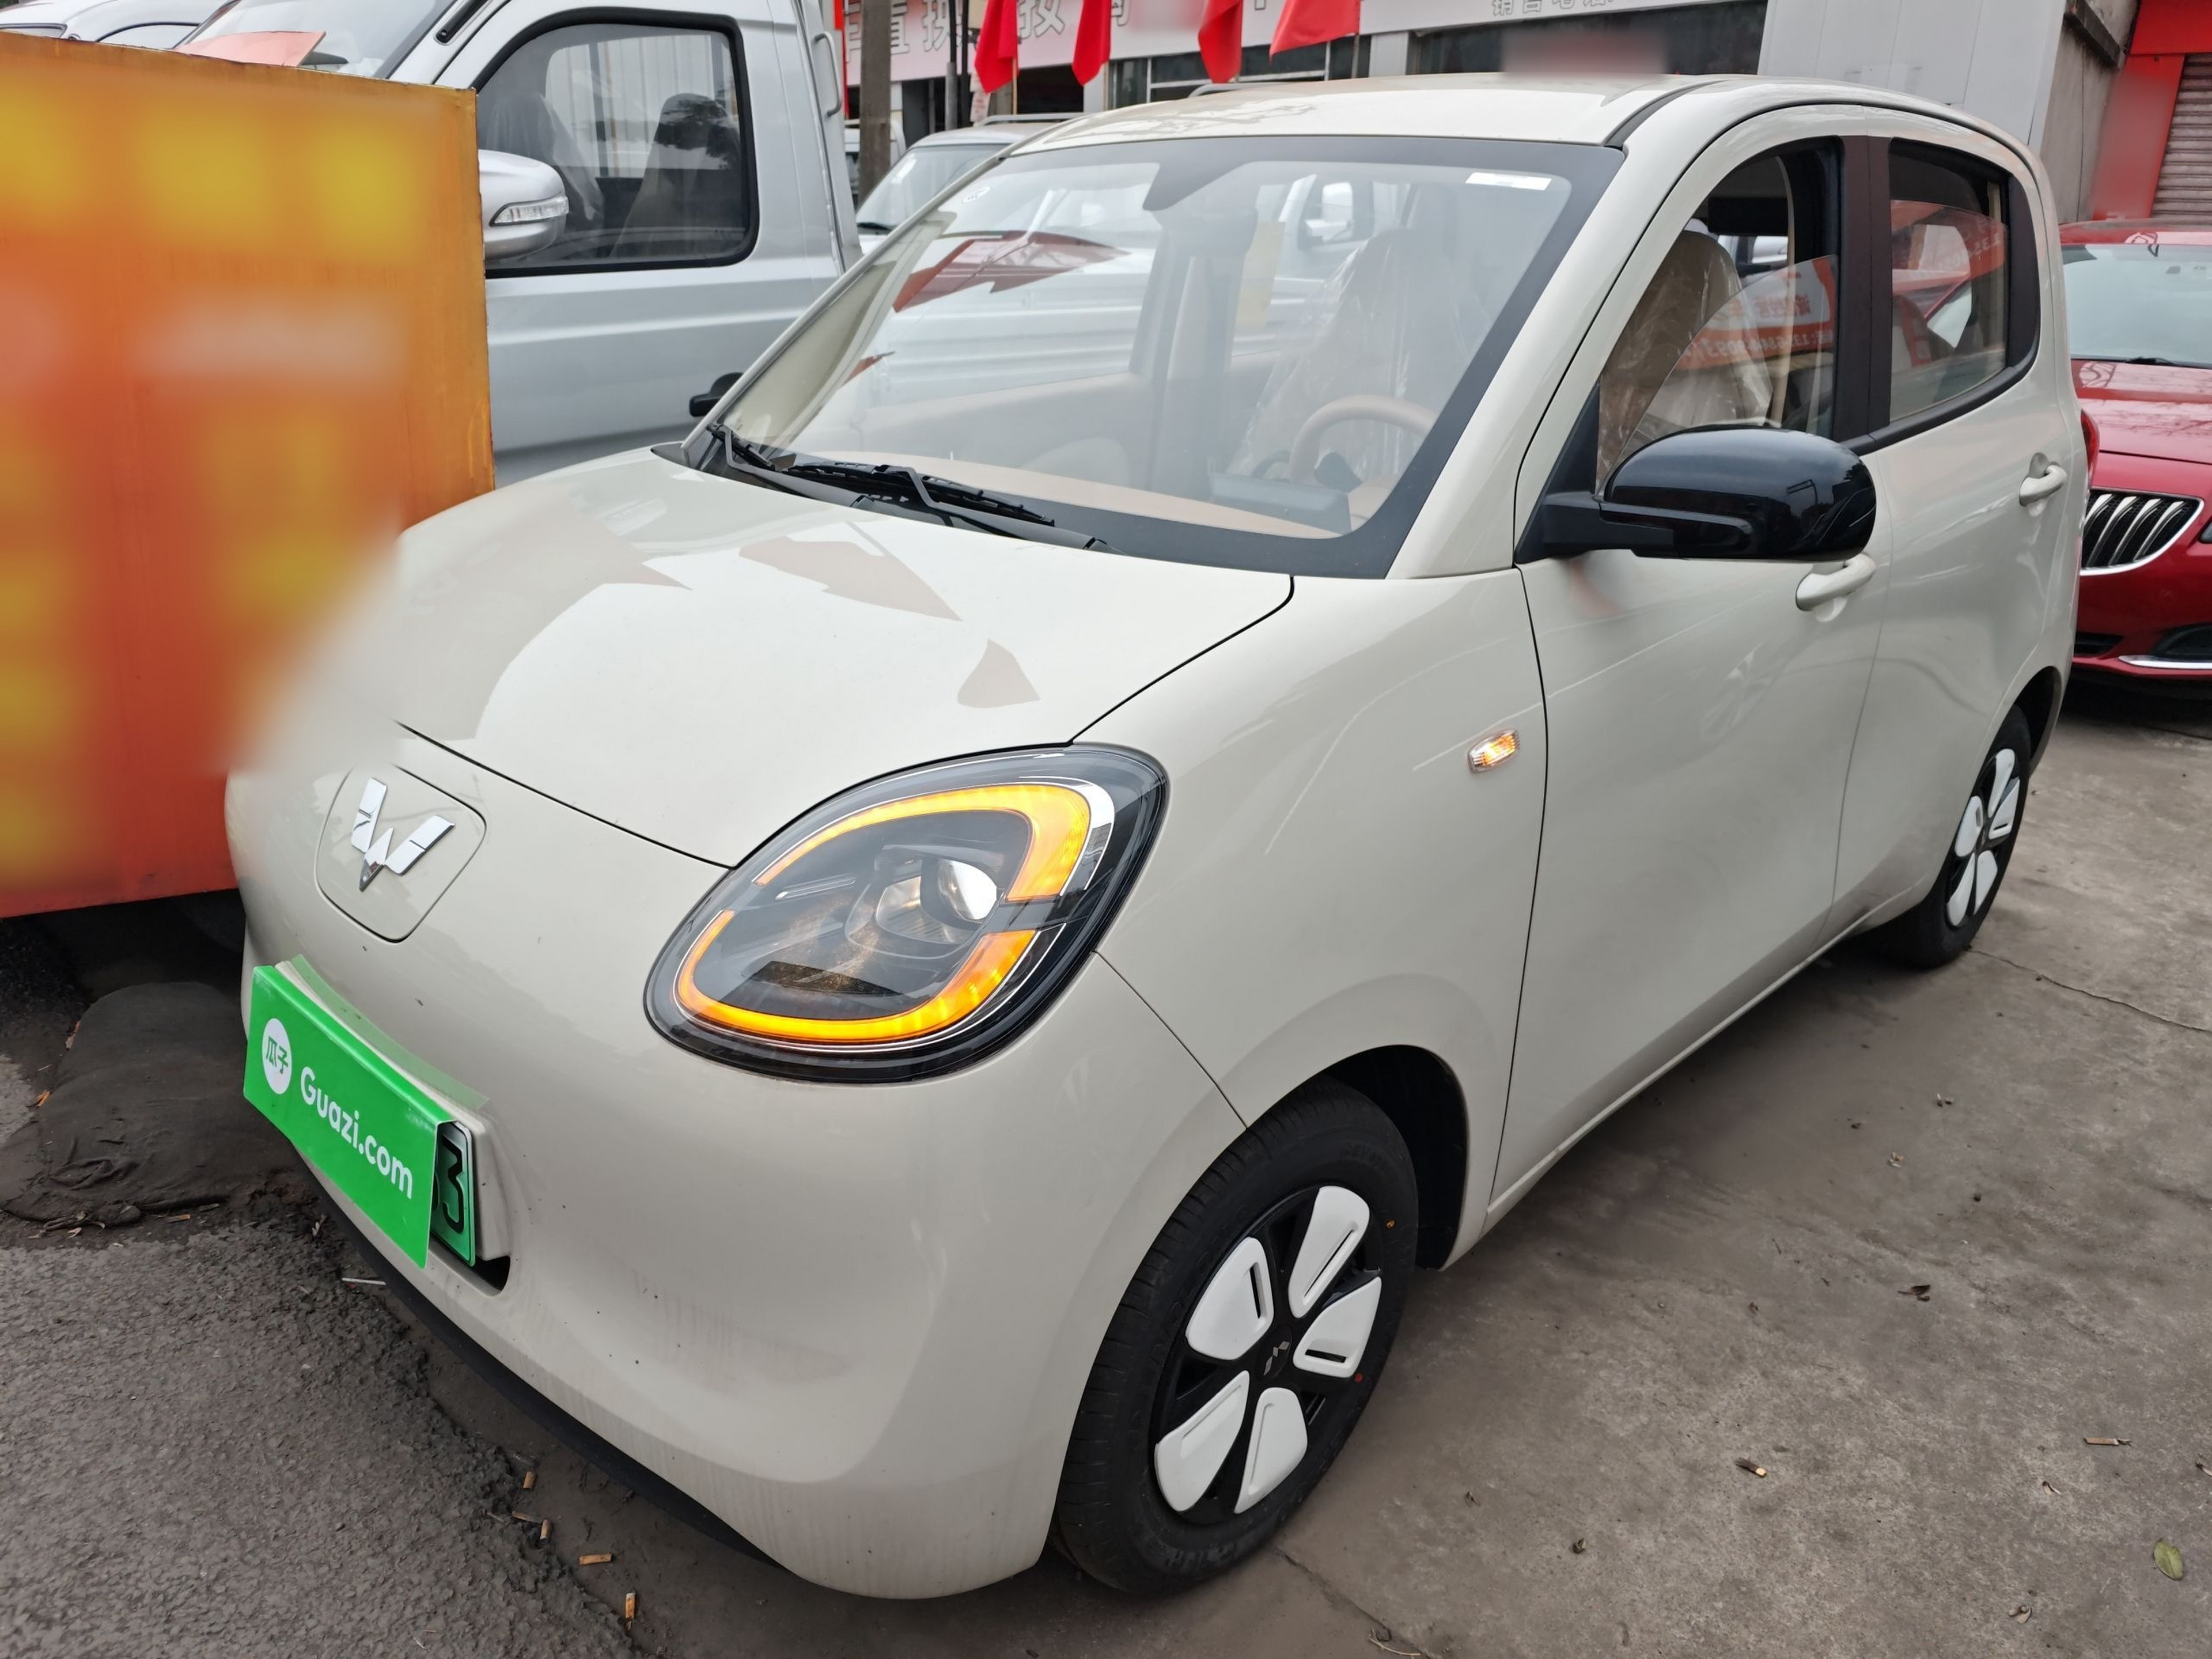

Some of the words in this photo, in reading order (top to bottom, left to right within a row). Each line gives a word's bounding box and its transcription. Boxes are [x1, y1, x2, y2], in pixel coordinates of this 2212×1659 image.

[266, 1036, 288, 1074] 瓜子
[300, 1066, 413, 1200] Guazi.com
[437, 1134, 465, 1234] 3
